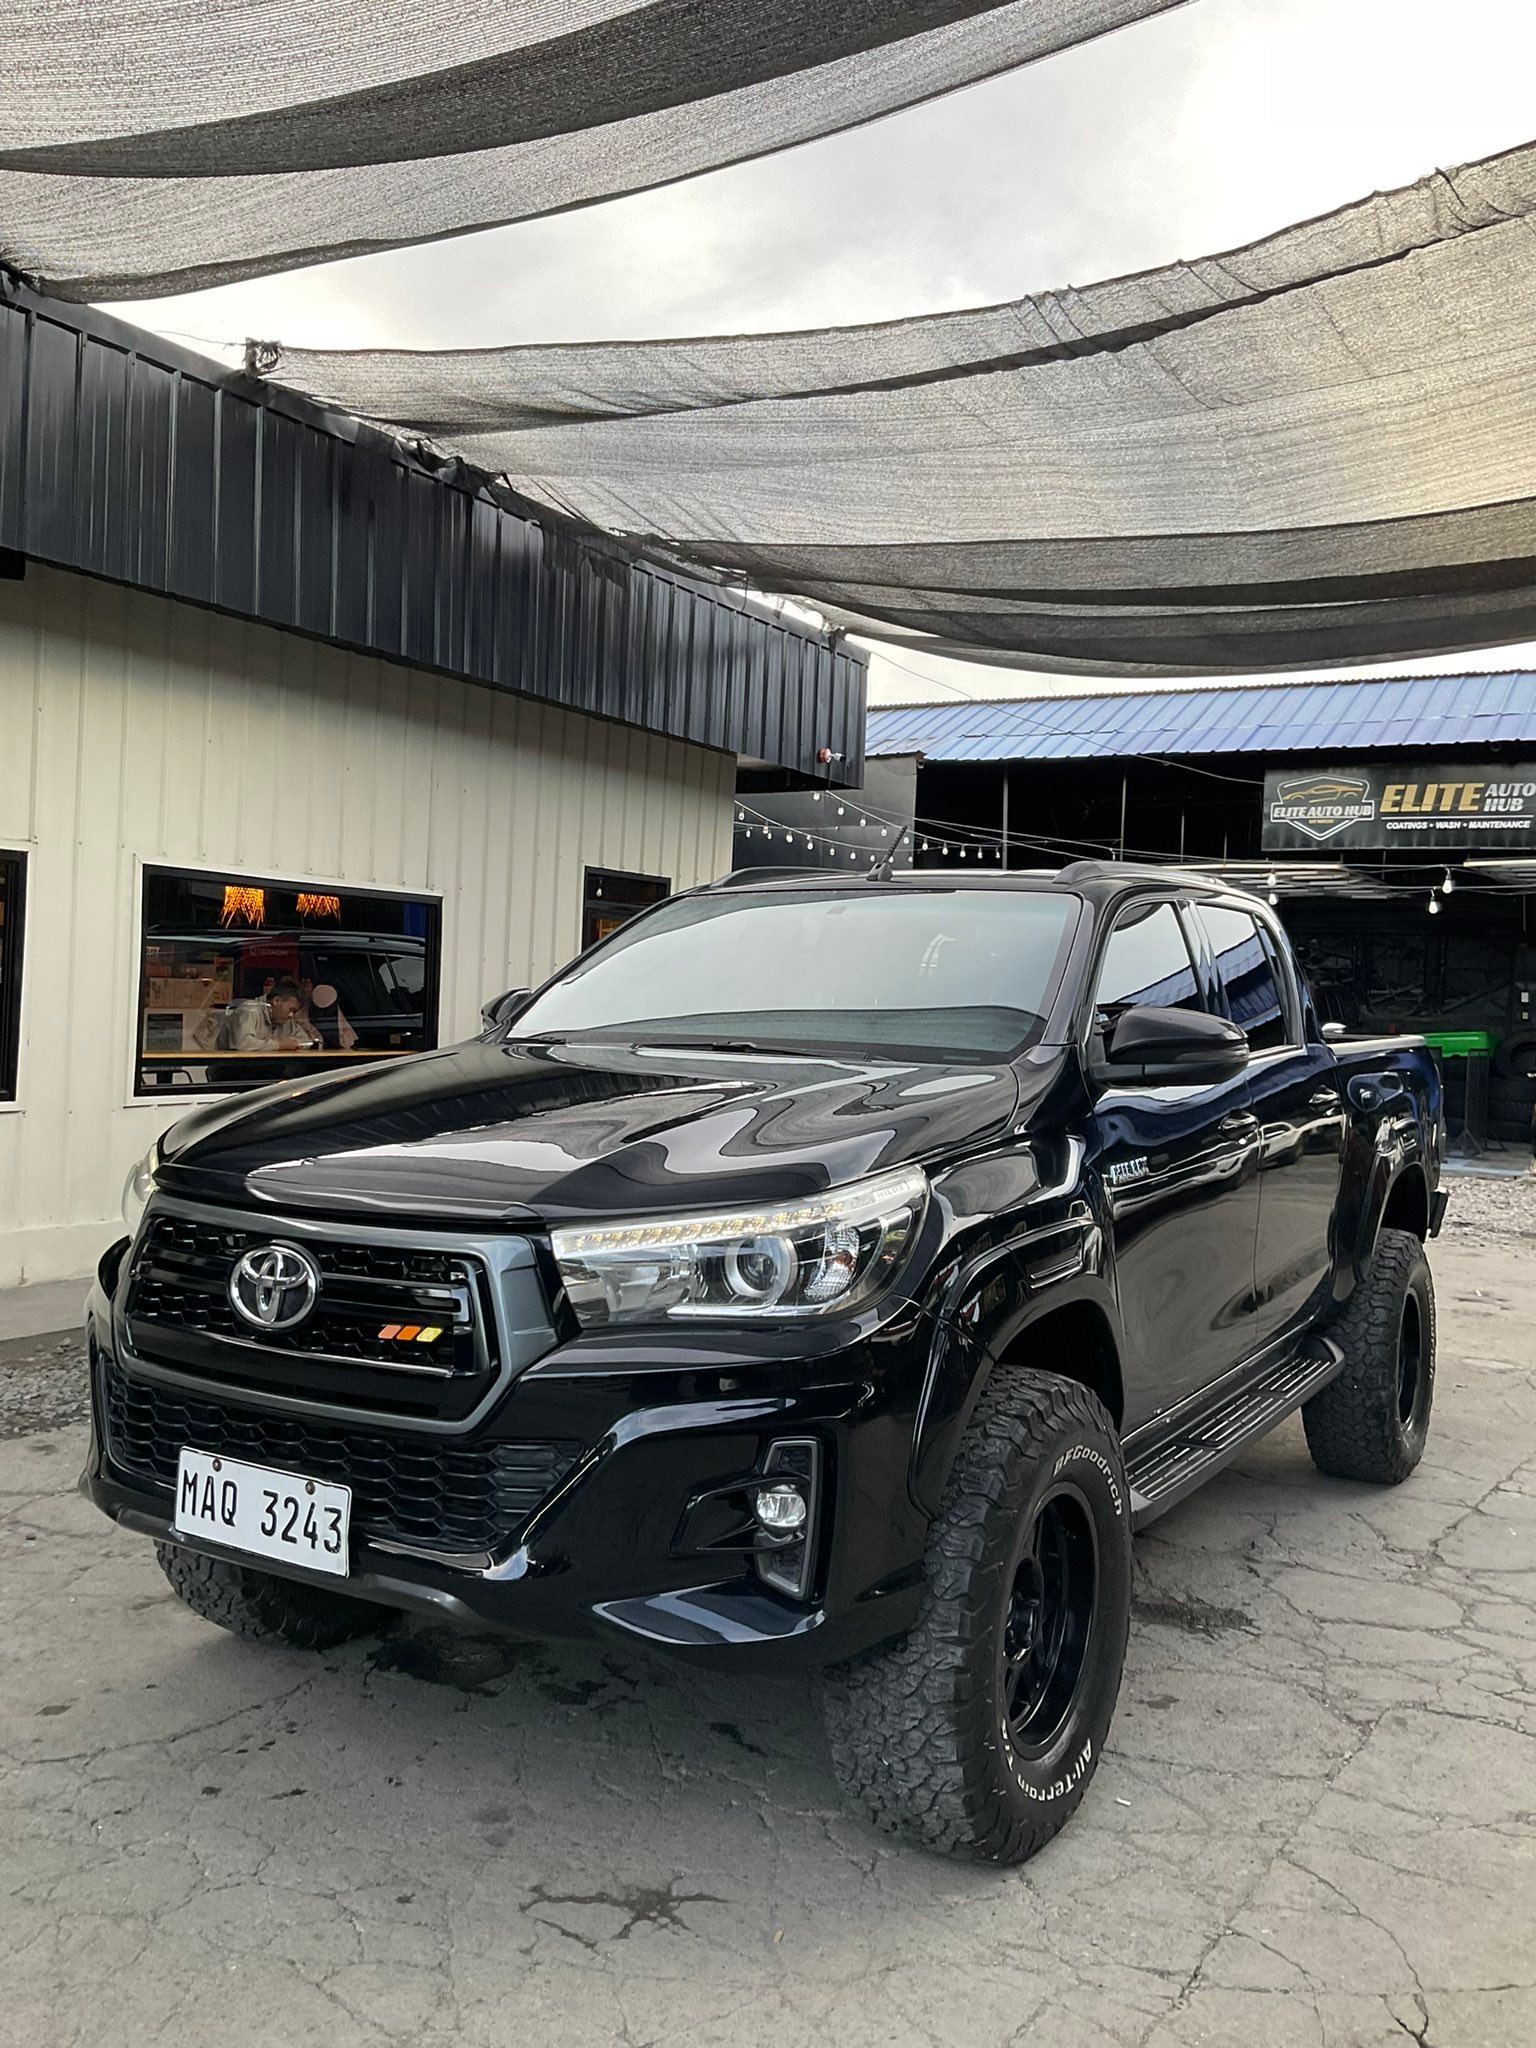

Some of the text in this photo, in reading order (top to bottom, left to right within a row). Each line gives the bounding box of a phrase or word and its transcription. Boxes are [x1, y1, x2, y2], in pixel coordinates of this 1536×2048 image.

[1379, 783, 1536, 813] ELITE AUTO
[1483, 798, 1524, 812] HUB
[1273, 805, 1371, 818] ELITE AUTO HUB
[1386, 820, 1531, 830] COATINGS WASH MAINTENANCE
[876, 1184, 905, 1199] HILUX
[1053, 1444, 1122, 1515] BFGoodrich
[181, 1469, 342, 1554] MAQ 3243
[1017, 1737, 1092, 1801] All-Terrain
